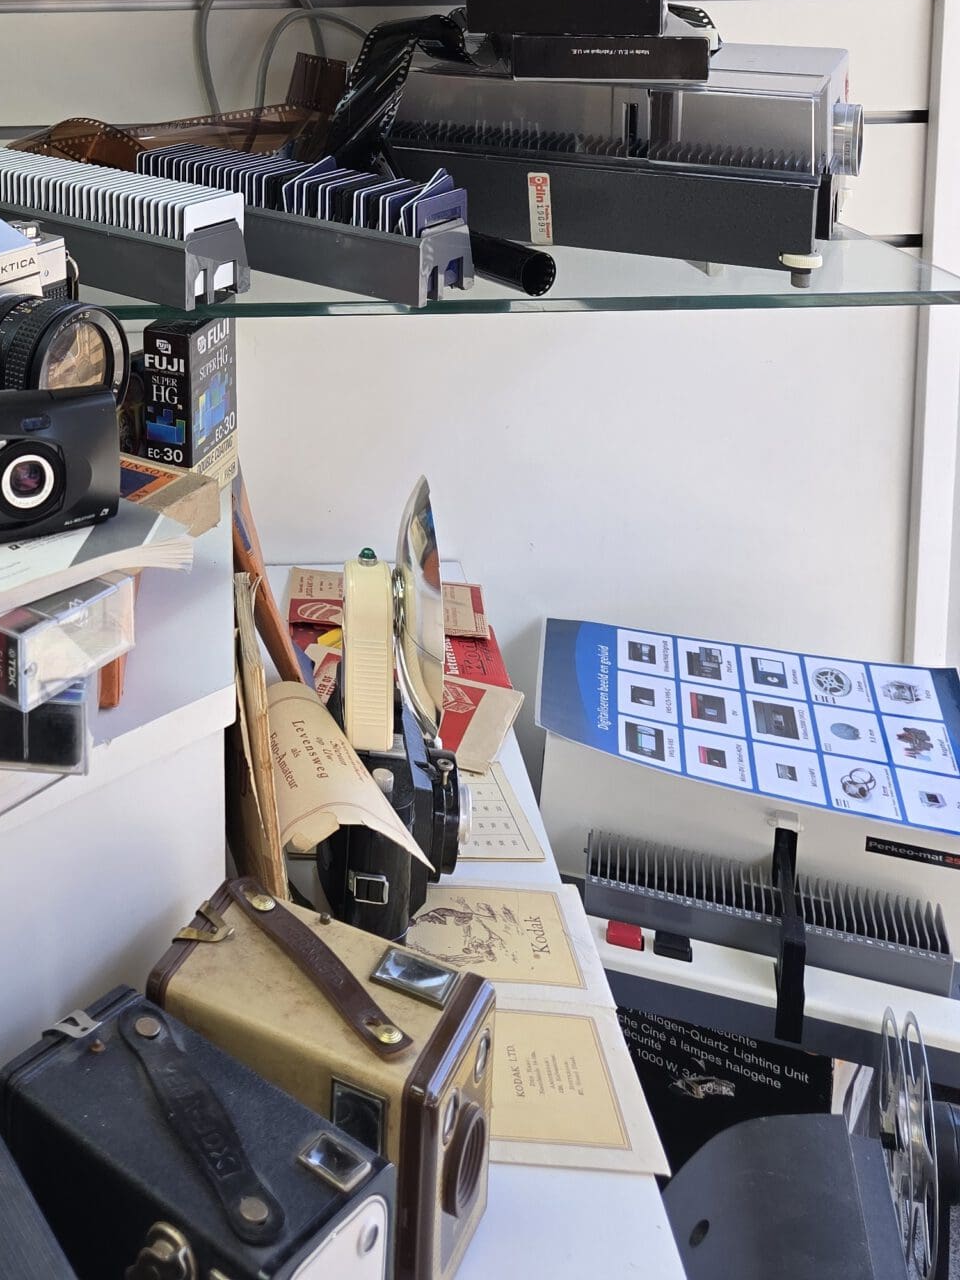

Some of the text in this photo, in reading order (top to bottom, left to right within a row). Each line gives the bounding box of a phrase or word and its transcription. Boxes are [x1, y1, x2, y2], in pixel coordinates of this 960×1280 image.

[208, 317, 230, 349] FUJI
[144, 353, 185, 373] FUJI
[217, 344, 229, 371] HG
[152, 375, 178, 387] SUPER
[152, 385, 179, 405] HG
[215, 411, 236, 443] EC-30
[147, 446, 184, 463] EC-30
[597, 644, 611, 665] geluid
[8, 659, 17, 688] TDK
[597, 673, 610, 693] beeld
[597, 692, 611, 731] Digitaliseren
[291, 719, 330, 780] Levensweg
[868, 840, 943, 862] Perkeo-mat
[527, 915, 551, 955] Kodak
[624, 1027, 663, 1052] écurité
[641, 1020, 667, 1041] Ciné
[680, 1040, 722, 1067] lampes
[636, 1048, 664, 1067] 1000
[733, 1047, 781, 1075] Lighting
[784, 1065, 810, 1084] Unit
[511, 1065, 525, 1098] KODAK
